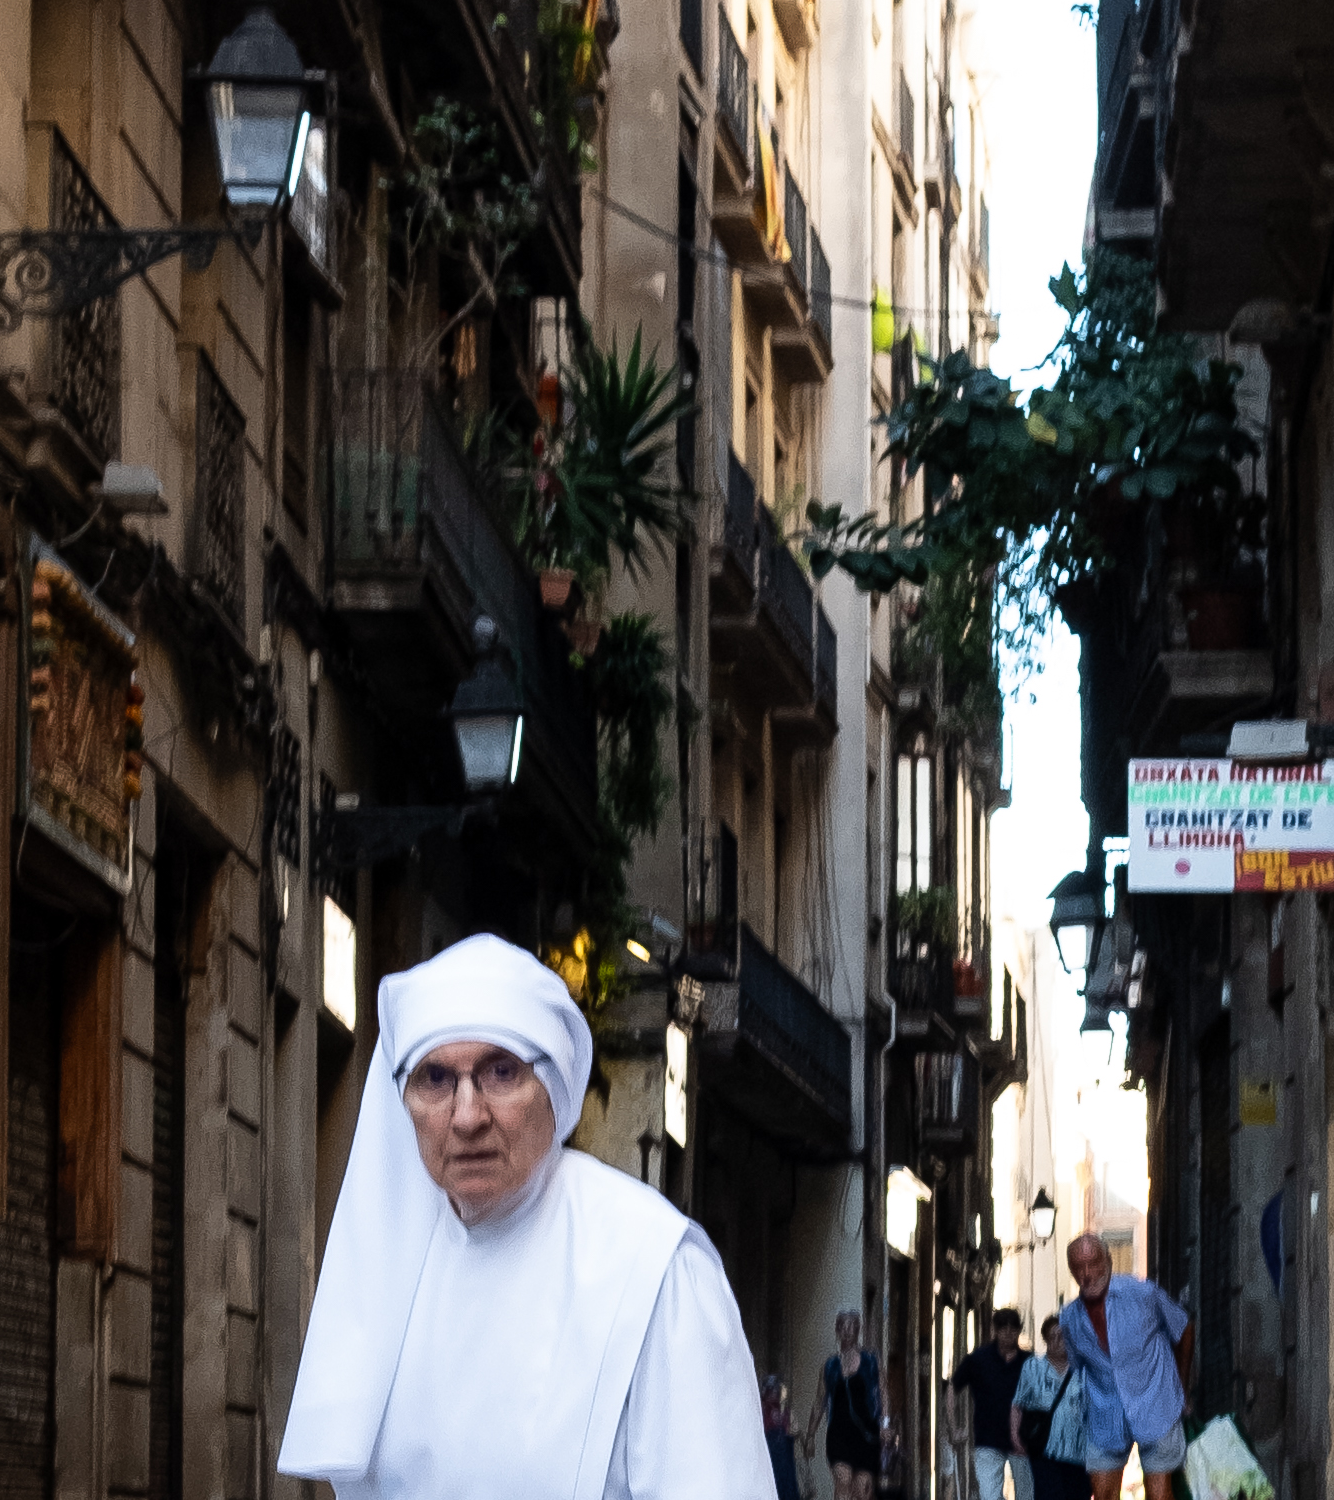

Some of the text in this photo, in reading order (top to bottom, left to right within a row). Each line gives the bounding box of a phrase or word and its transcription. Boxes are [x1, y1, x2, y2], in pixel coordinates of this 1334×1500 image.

[1246, 784, 1275, 807] DE
[1145, 808, 1312, 830] GRANITZAT DE
